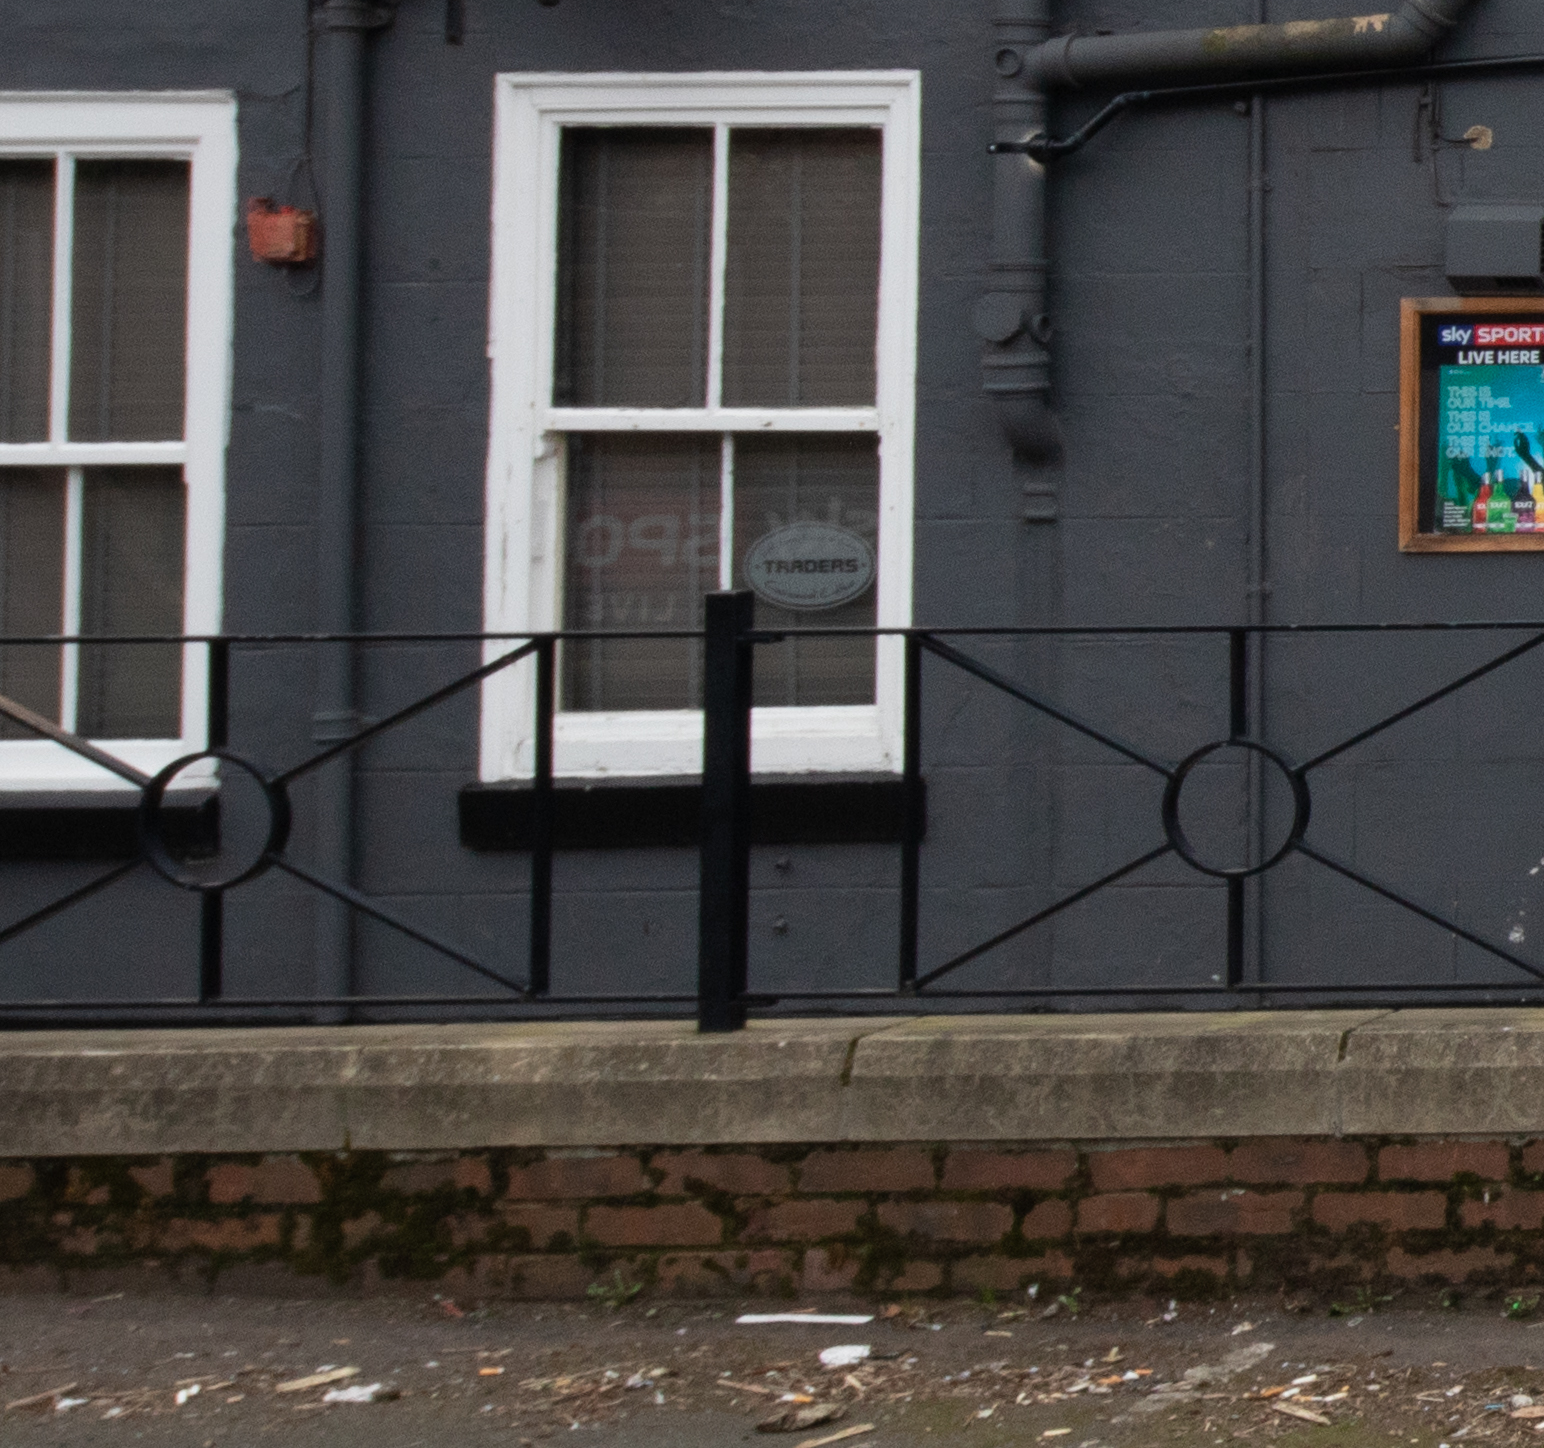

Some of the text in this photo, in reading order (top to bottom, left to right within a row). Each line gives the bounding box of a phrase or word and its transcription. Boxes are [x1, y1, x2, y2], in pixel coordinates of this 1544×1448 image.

[1441, 326, 1472, 345] sky
[1458, 350, 1540, 364] LIVE HERE
[763, 558, 859, 576] TRADERS
